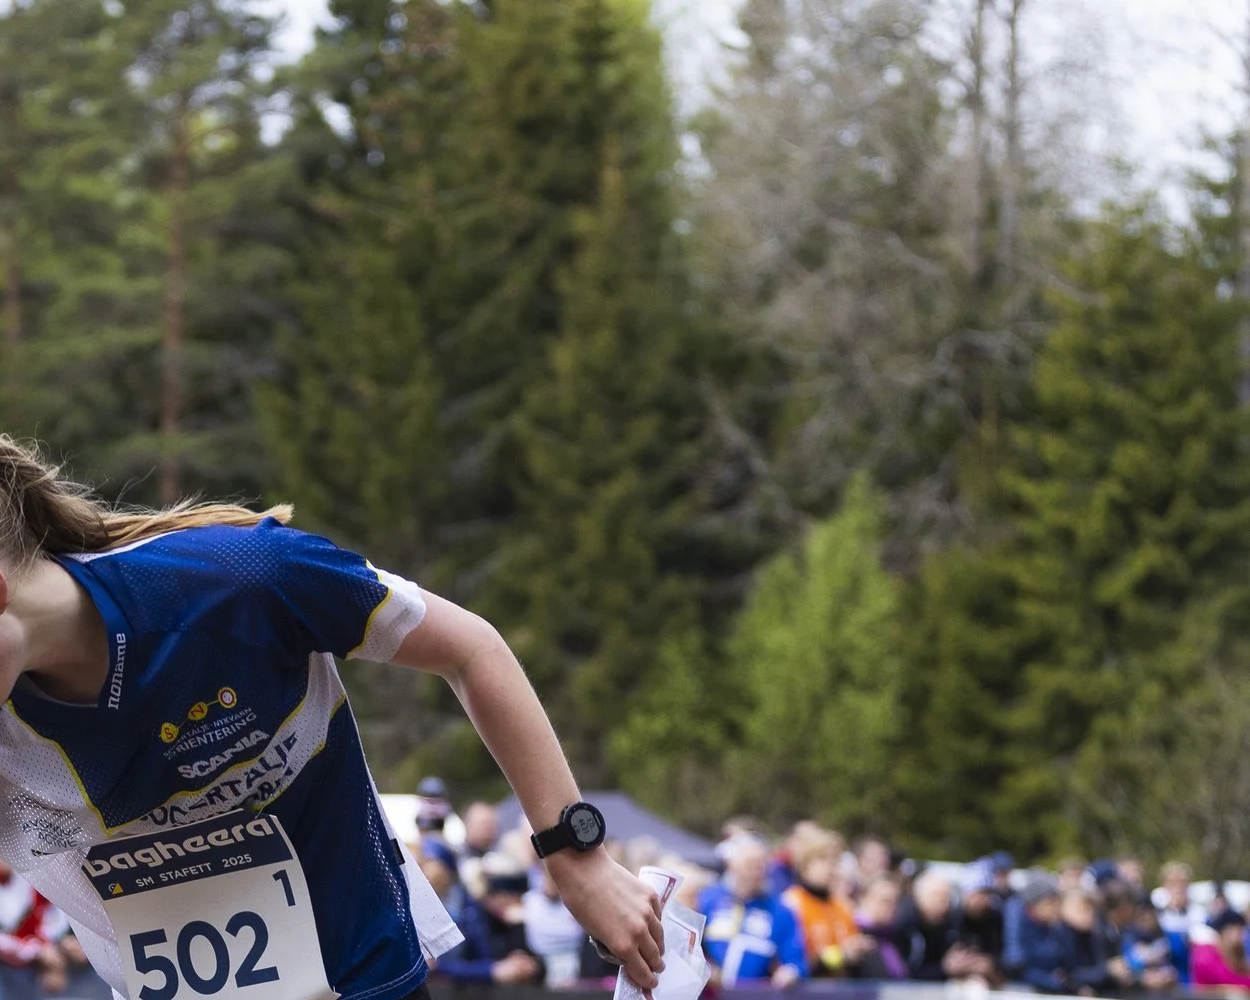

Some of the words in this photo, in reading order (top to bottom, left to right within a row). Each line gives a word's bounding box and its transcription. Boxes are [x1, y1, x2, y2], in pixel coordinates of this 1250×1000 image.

[108, 633, 126, 710] noname
[178, 729, 270, 779] SCANIA
[85, 818, 274, 878] bagheera
[135, 873, 154, 887] SM
[159, 863, 212, 882] STAFETT
[222, 854, 252, 868] 2025
[272, 869, 296, 907] 1
